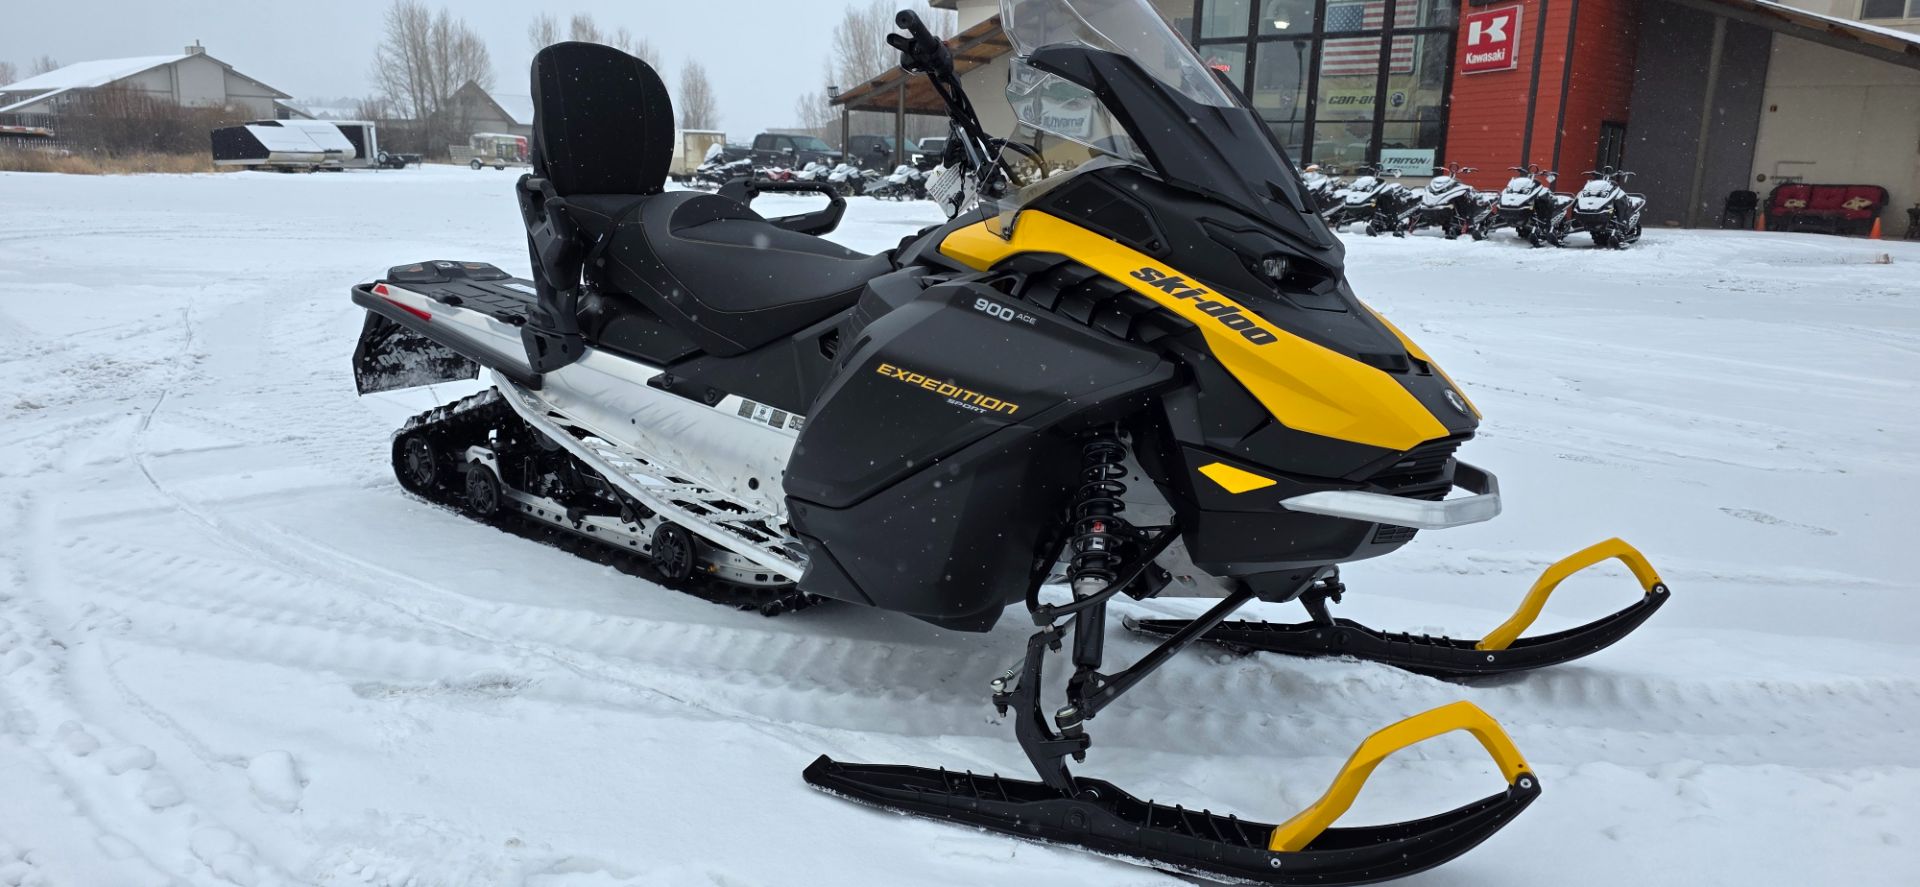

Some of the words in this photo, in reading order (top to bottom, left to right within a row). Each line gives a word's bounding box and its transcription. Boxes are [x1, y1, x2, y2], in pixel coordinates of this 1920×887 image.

[1465, 47, 1506, 65] Kawasaki
[973, 297, 1015, 322] 900
[1016, 312, 1037, 325] ACE
[1129, 266, 1278, 346] ski-doo
[876, 362, 1019, 415] EXPEDITION
[946, 398, 989, 414] SPORT
